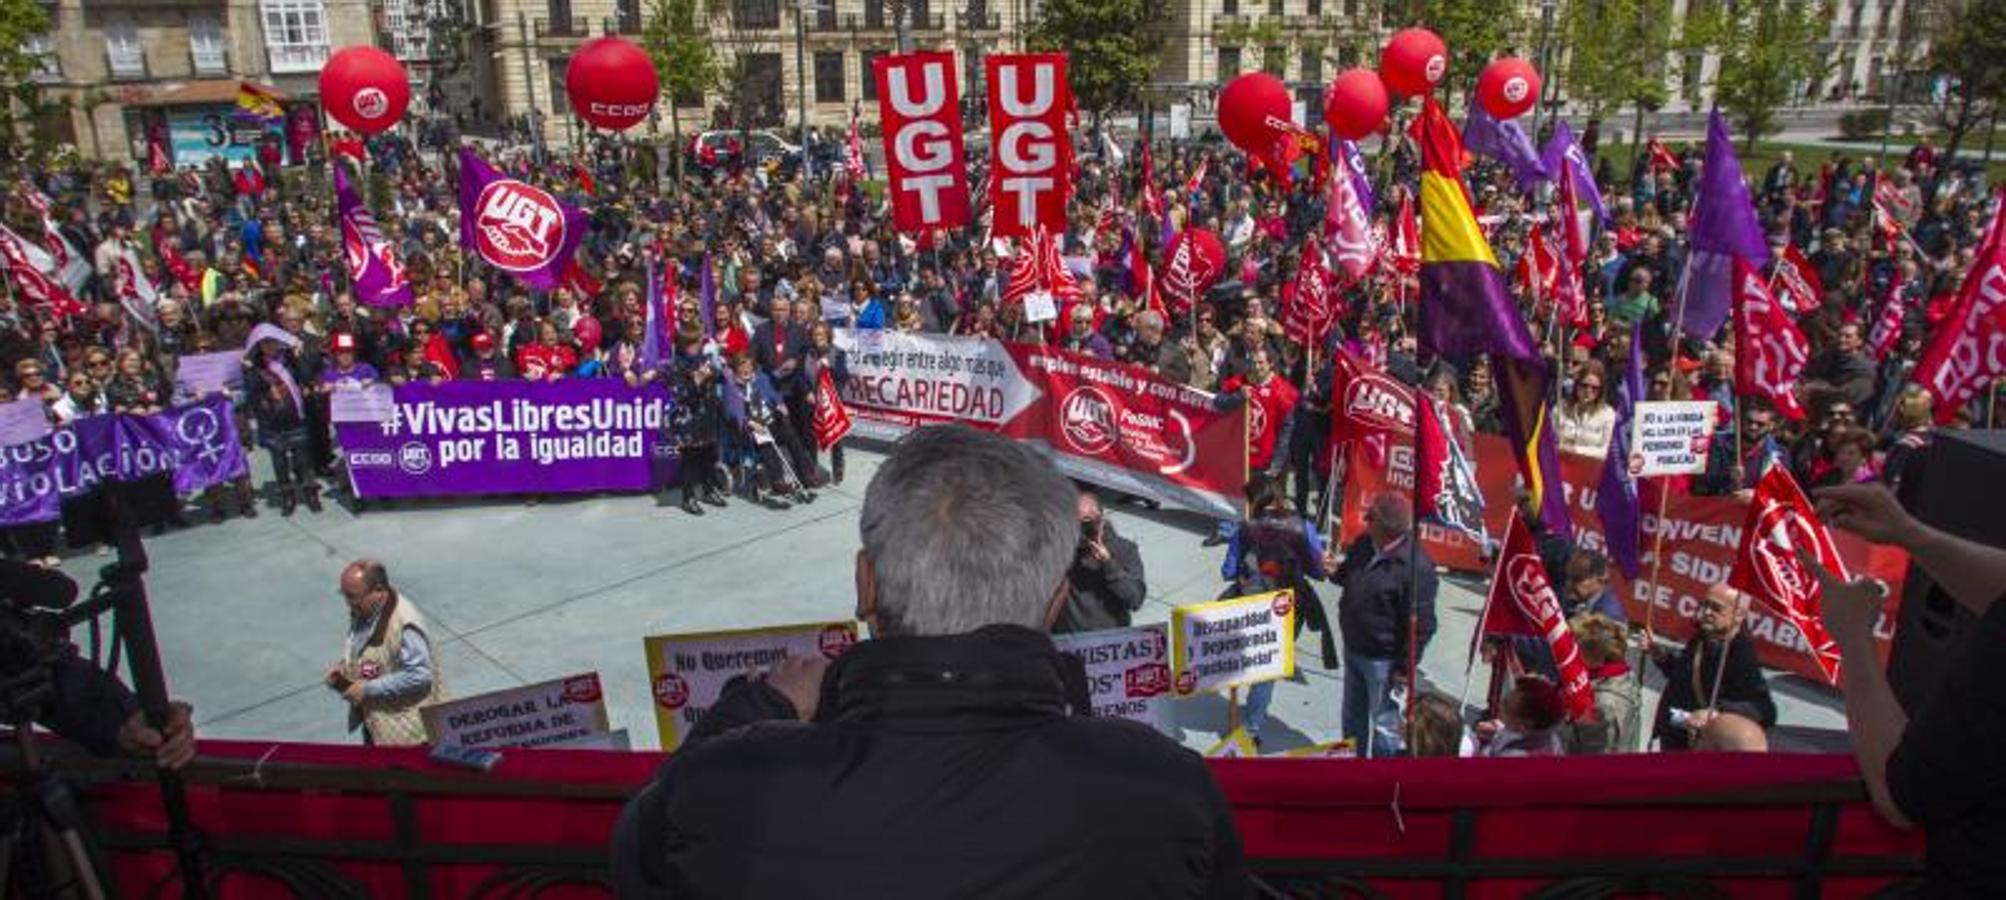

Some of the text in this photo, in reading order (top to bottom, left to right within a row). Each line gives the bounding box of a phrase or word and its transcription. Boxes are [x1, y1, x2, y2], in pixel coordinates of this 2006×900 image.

[887, 62, 955, 223] UGT
[1000, 63, 1056, 226] UGT
[484, 185, 558, 243] UGT
[847, 375, 1004, 419] RECARIEDAD
[1081, 364, 1134, 390] estable
[1137, 380, 1147, 395] y
[1151, 384, 1176, 400] con
[1068, 396, 1108, 425] UGT
[1351, 383, 1414, 424] UGT
[438, 431, 643, 467] por la igualdad
[450, 700, 540, 730] DEROGAR
[460, 722, 547, 746] REFORMA
[552, 713, 575, 728] DE
